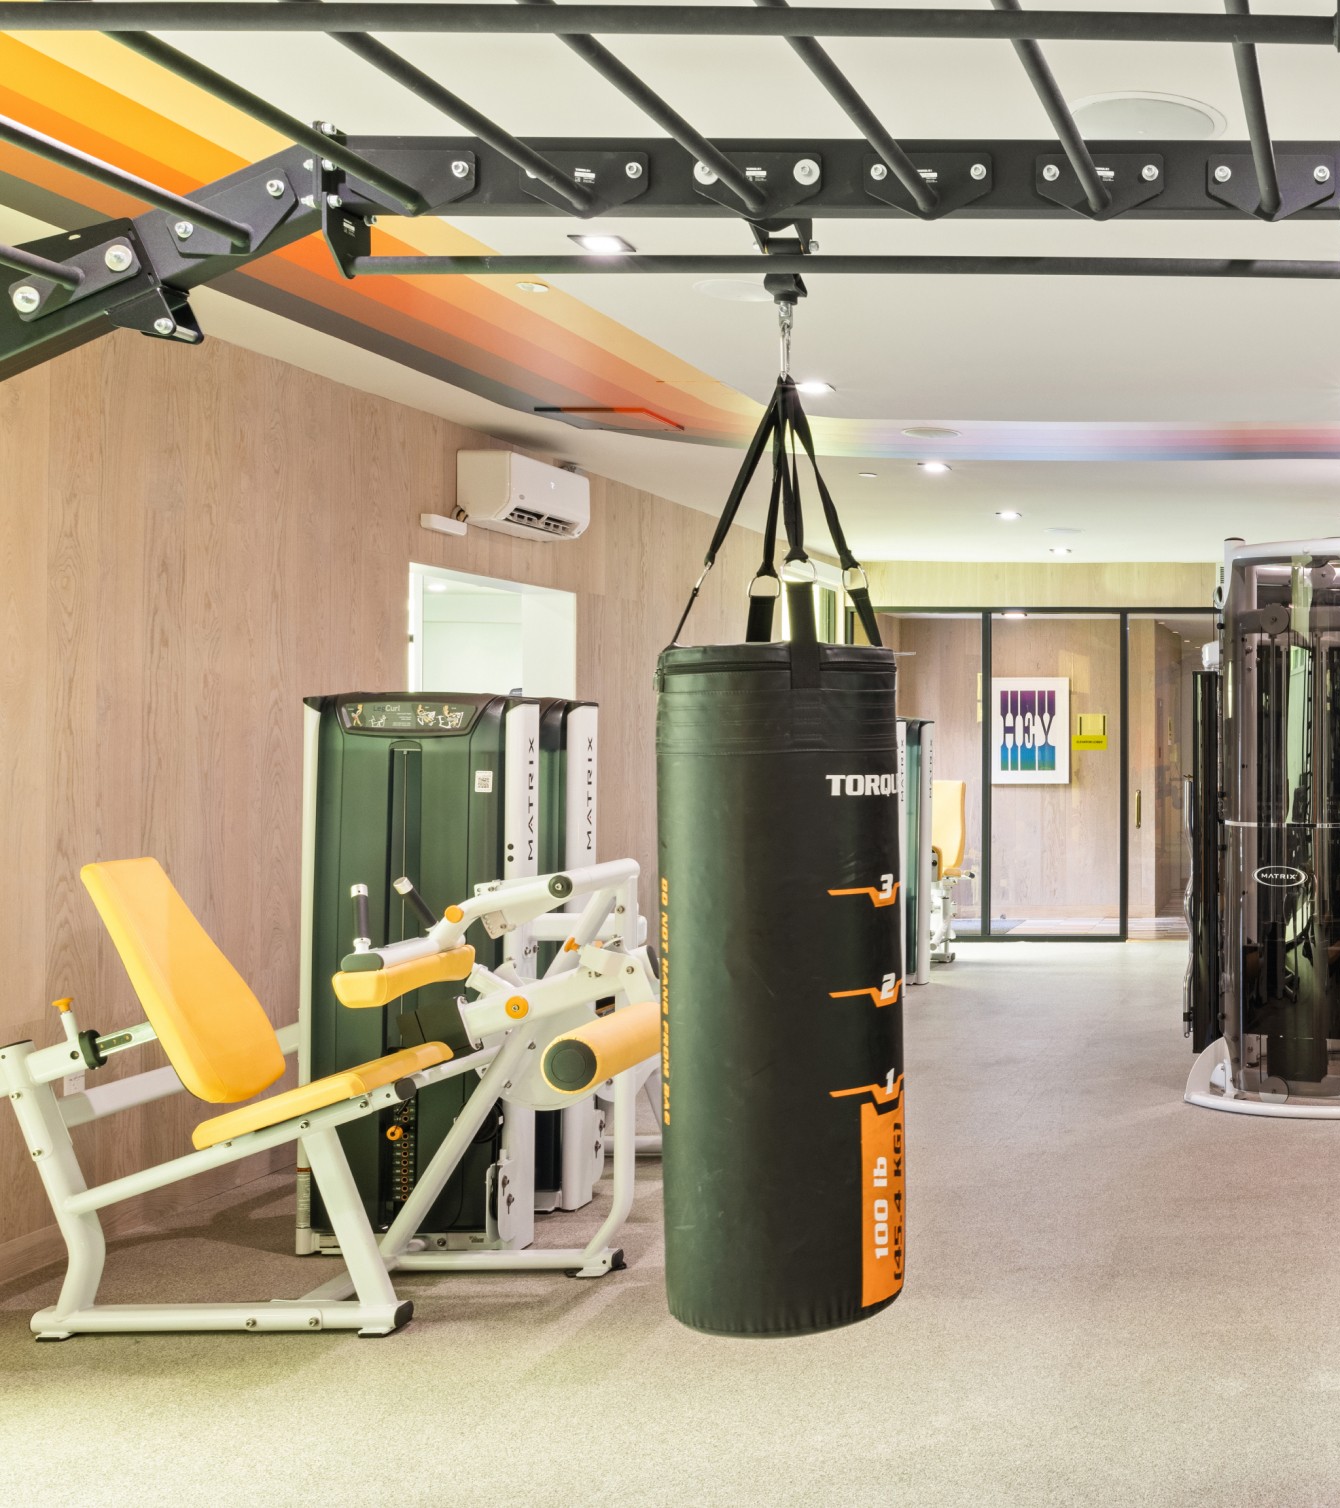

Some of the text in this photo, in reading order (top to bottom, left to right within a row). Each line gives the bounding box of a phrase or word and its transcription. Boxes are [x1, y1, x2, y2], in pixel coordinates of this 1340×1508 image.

[1000, 690, 1056, 770] HEY
[661, 878, 668, 906] DO
[879, 873, 894, 899] 3
[880, 972, 896, 1000] 2
[885, 1068, 895, 1095] 1
[873, 1157, 888, 1259] 100 lb
